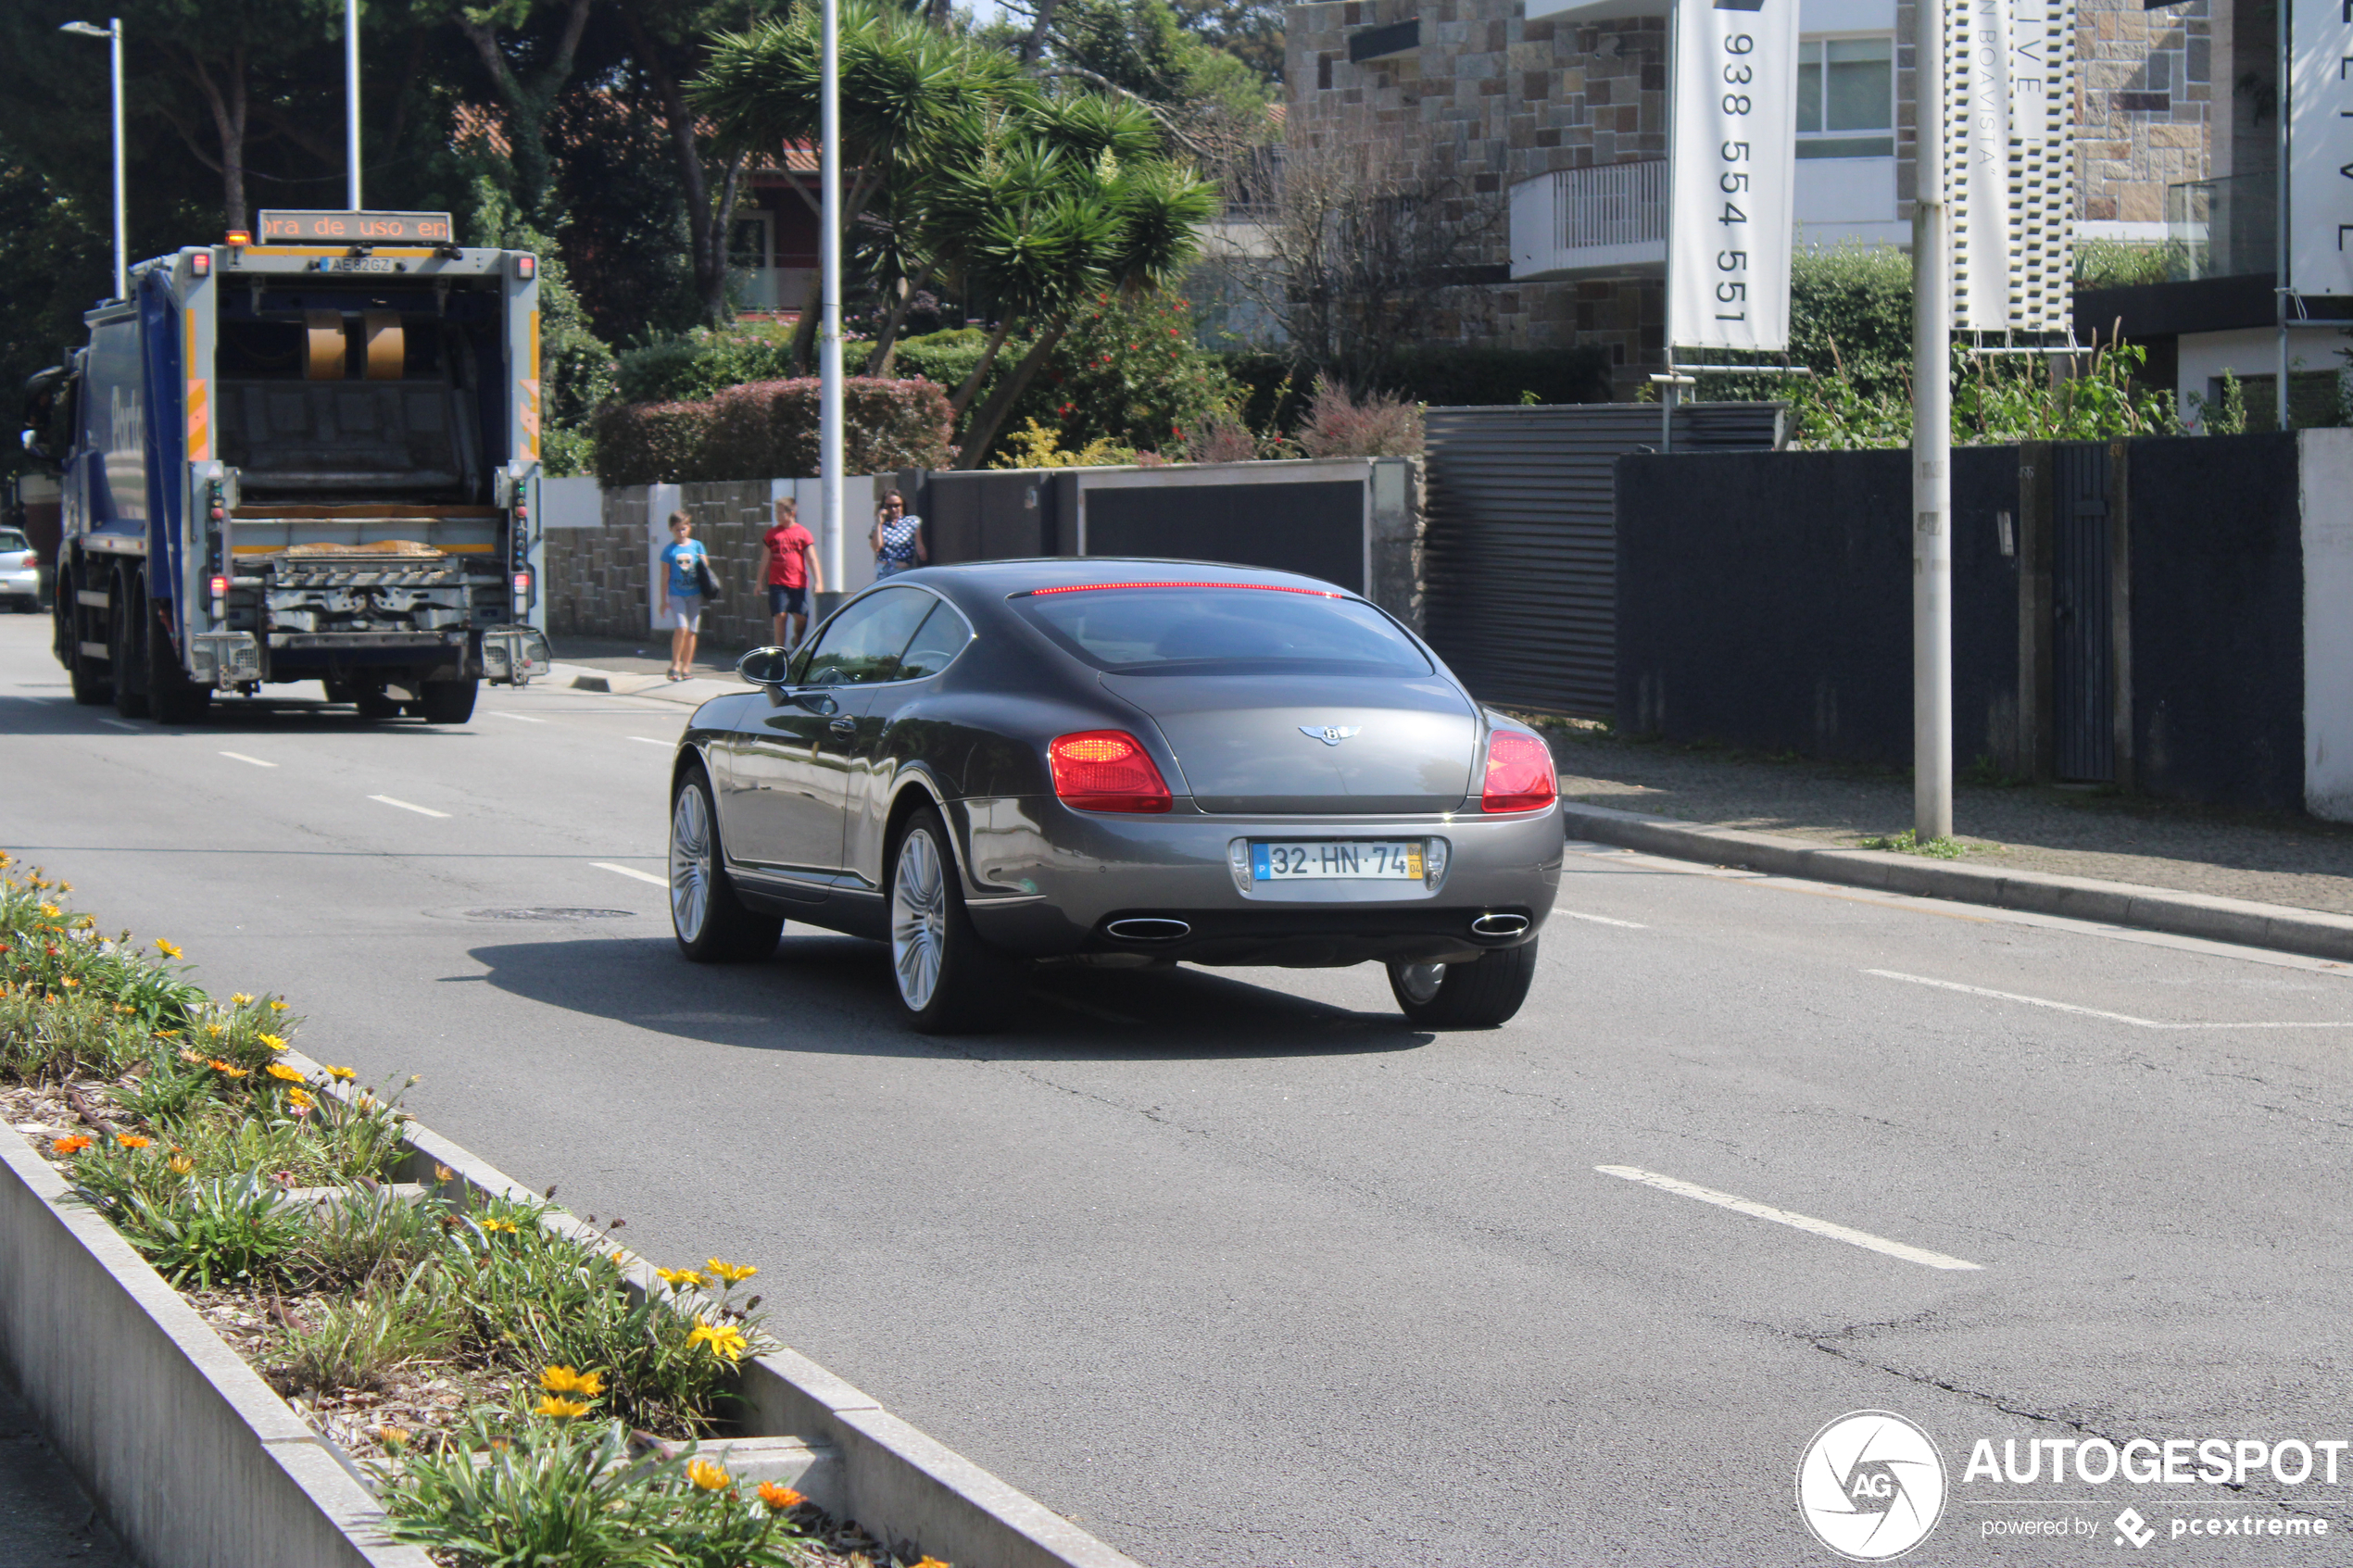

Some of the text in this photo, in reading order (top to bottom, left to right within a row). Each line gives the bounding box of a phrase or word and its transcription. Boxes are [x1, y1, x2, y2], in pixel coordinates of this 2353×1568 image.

[1715, 32, 1754, 321] 938 554 551
[314, 217, 345, 235] de
[359, 220, 403, 236] uso
[1408, 847, 1420, 856] 09
[1258, 864, 1266, 873] P
[1409, 864, 1421, 873] 04
